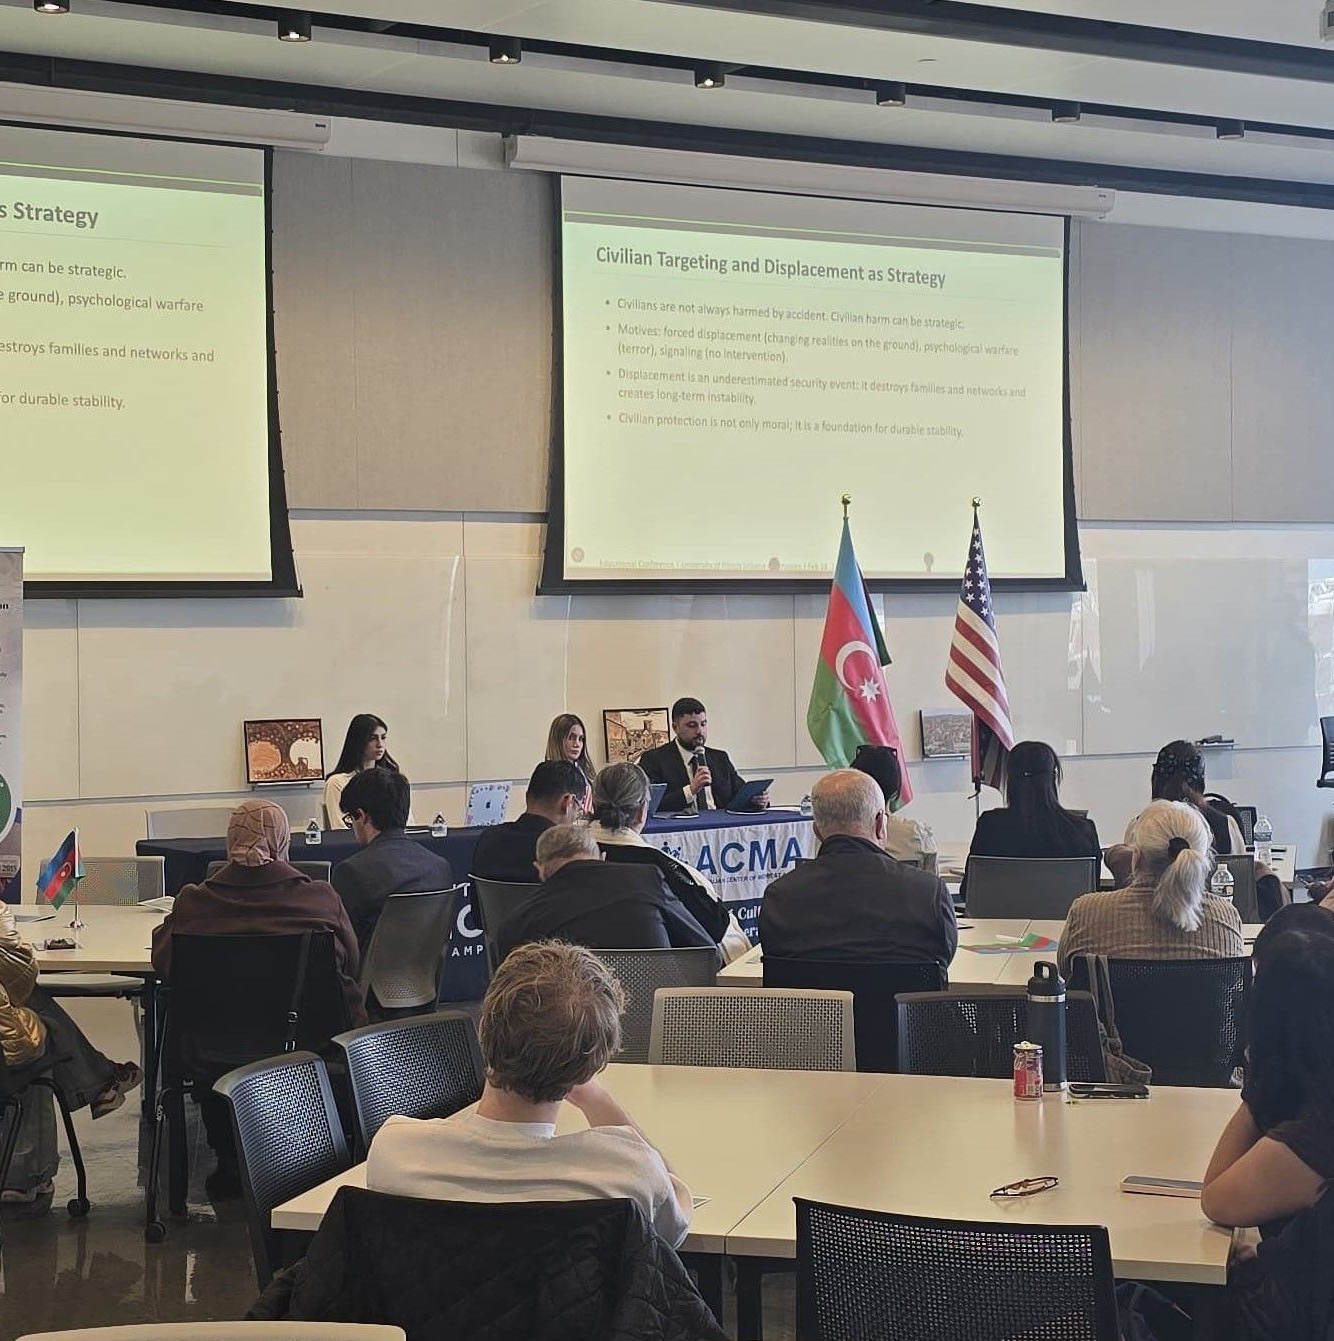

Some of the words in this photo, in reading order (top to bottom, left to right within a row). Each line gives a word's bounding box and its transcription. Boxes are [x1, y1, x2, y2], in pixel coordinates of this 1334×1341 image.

[13, 202, 99, 229] Strategy
[21, 262, 44, 273] can
[48, 260, 64, 274] be
[68, 264, 126, 280] strategic.
[596, 246, 652, 266] Civilian
[656, 251, 728, 275] Targeting
[732, 257, 760, 273] and
[765, 259, 865, 281] Displacement
[868, 269, 883, 282] as
[887, 267, 946, 289] Strategy
[8, 289, 64, 306] ground),
[68, 293, 152, 310] psychological
[156, 298, 203, 312] warfare
[48, 341, 99, 356] families
[103, 345, 126, 358] and
[130, 348, 189, 361] networks
[191, 349, 215, 362] and
[19, 392, 69, 408] durable
[73, 394, 125, 411] stability.
[696, 836, 803, 875] ACMA
